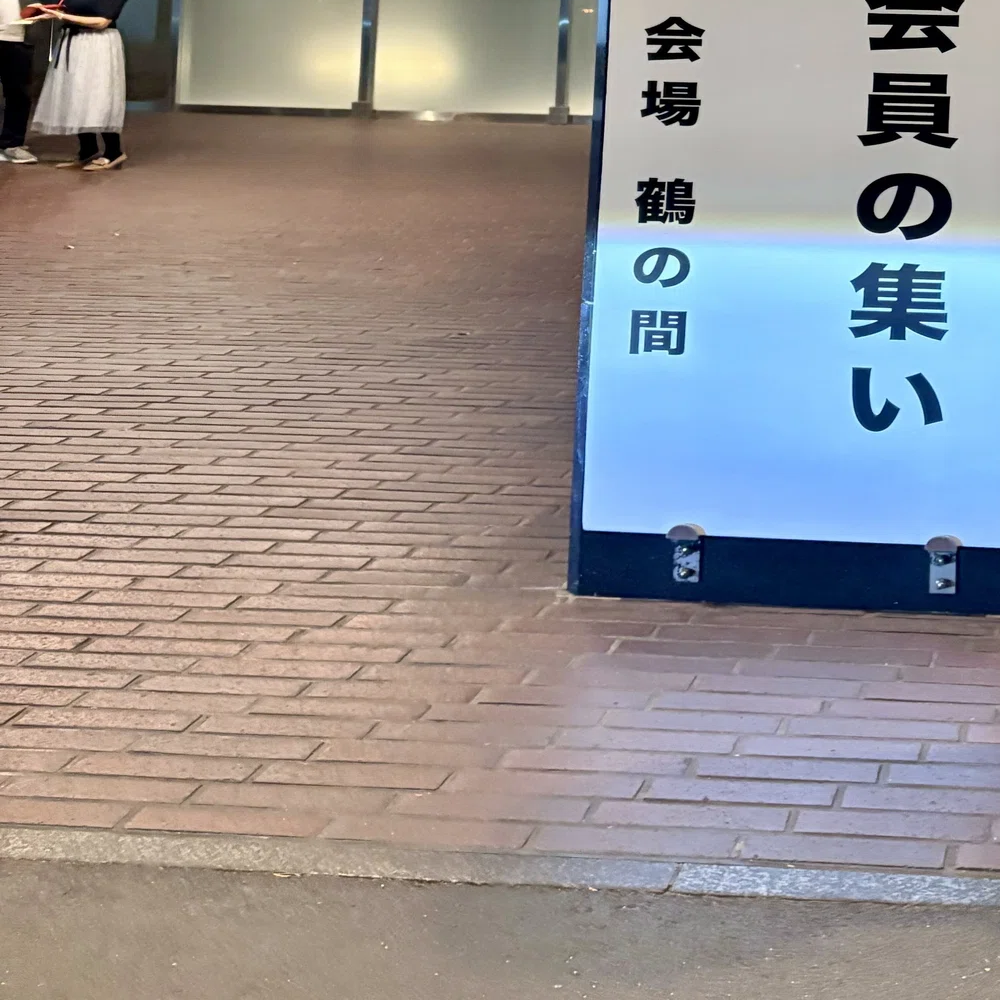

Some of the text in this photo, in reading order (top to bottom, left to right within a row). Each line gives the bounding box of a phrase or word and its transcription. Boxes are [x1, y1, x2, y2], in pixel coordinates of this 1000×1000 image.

[628, 16, 706, 357] 会場 鶴の間
